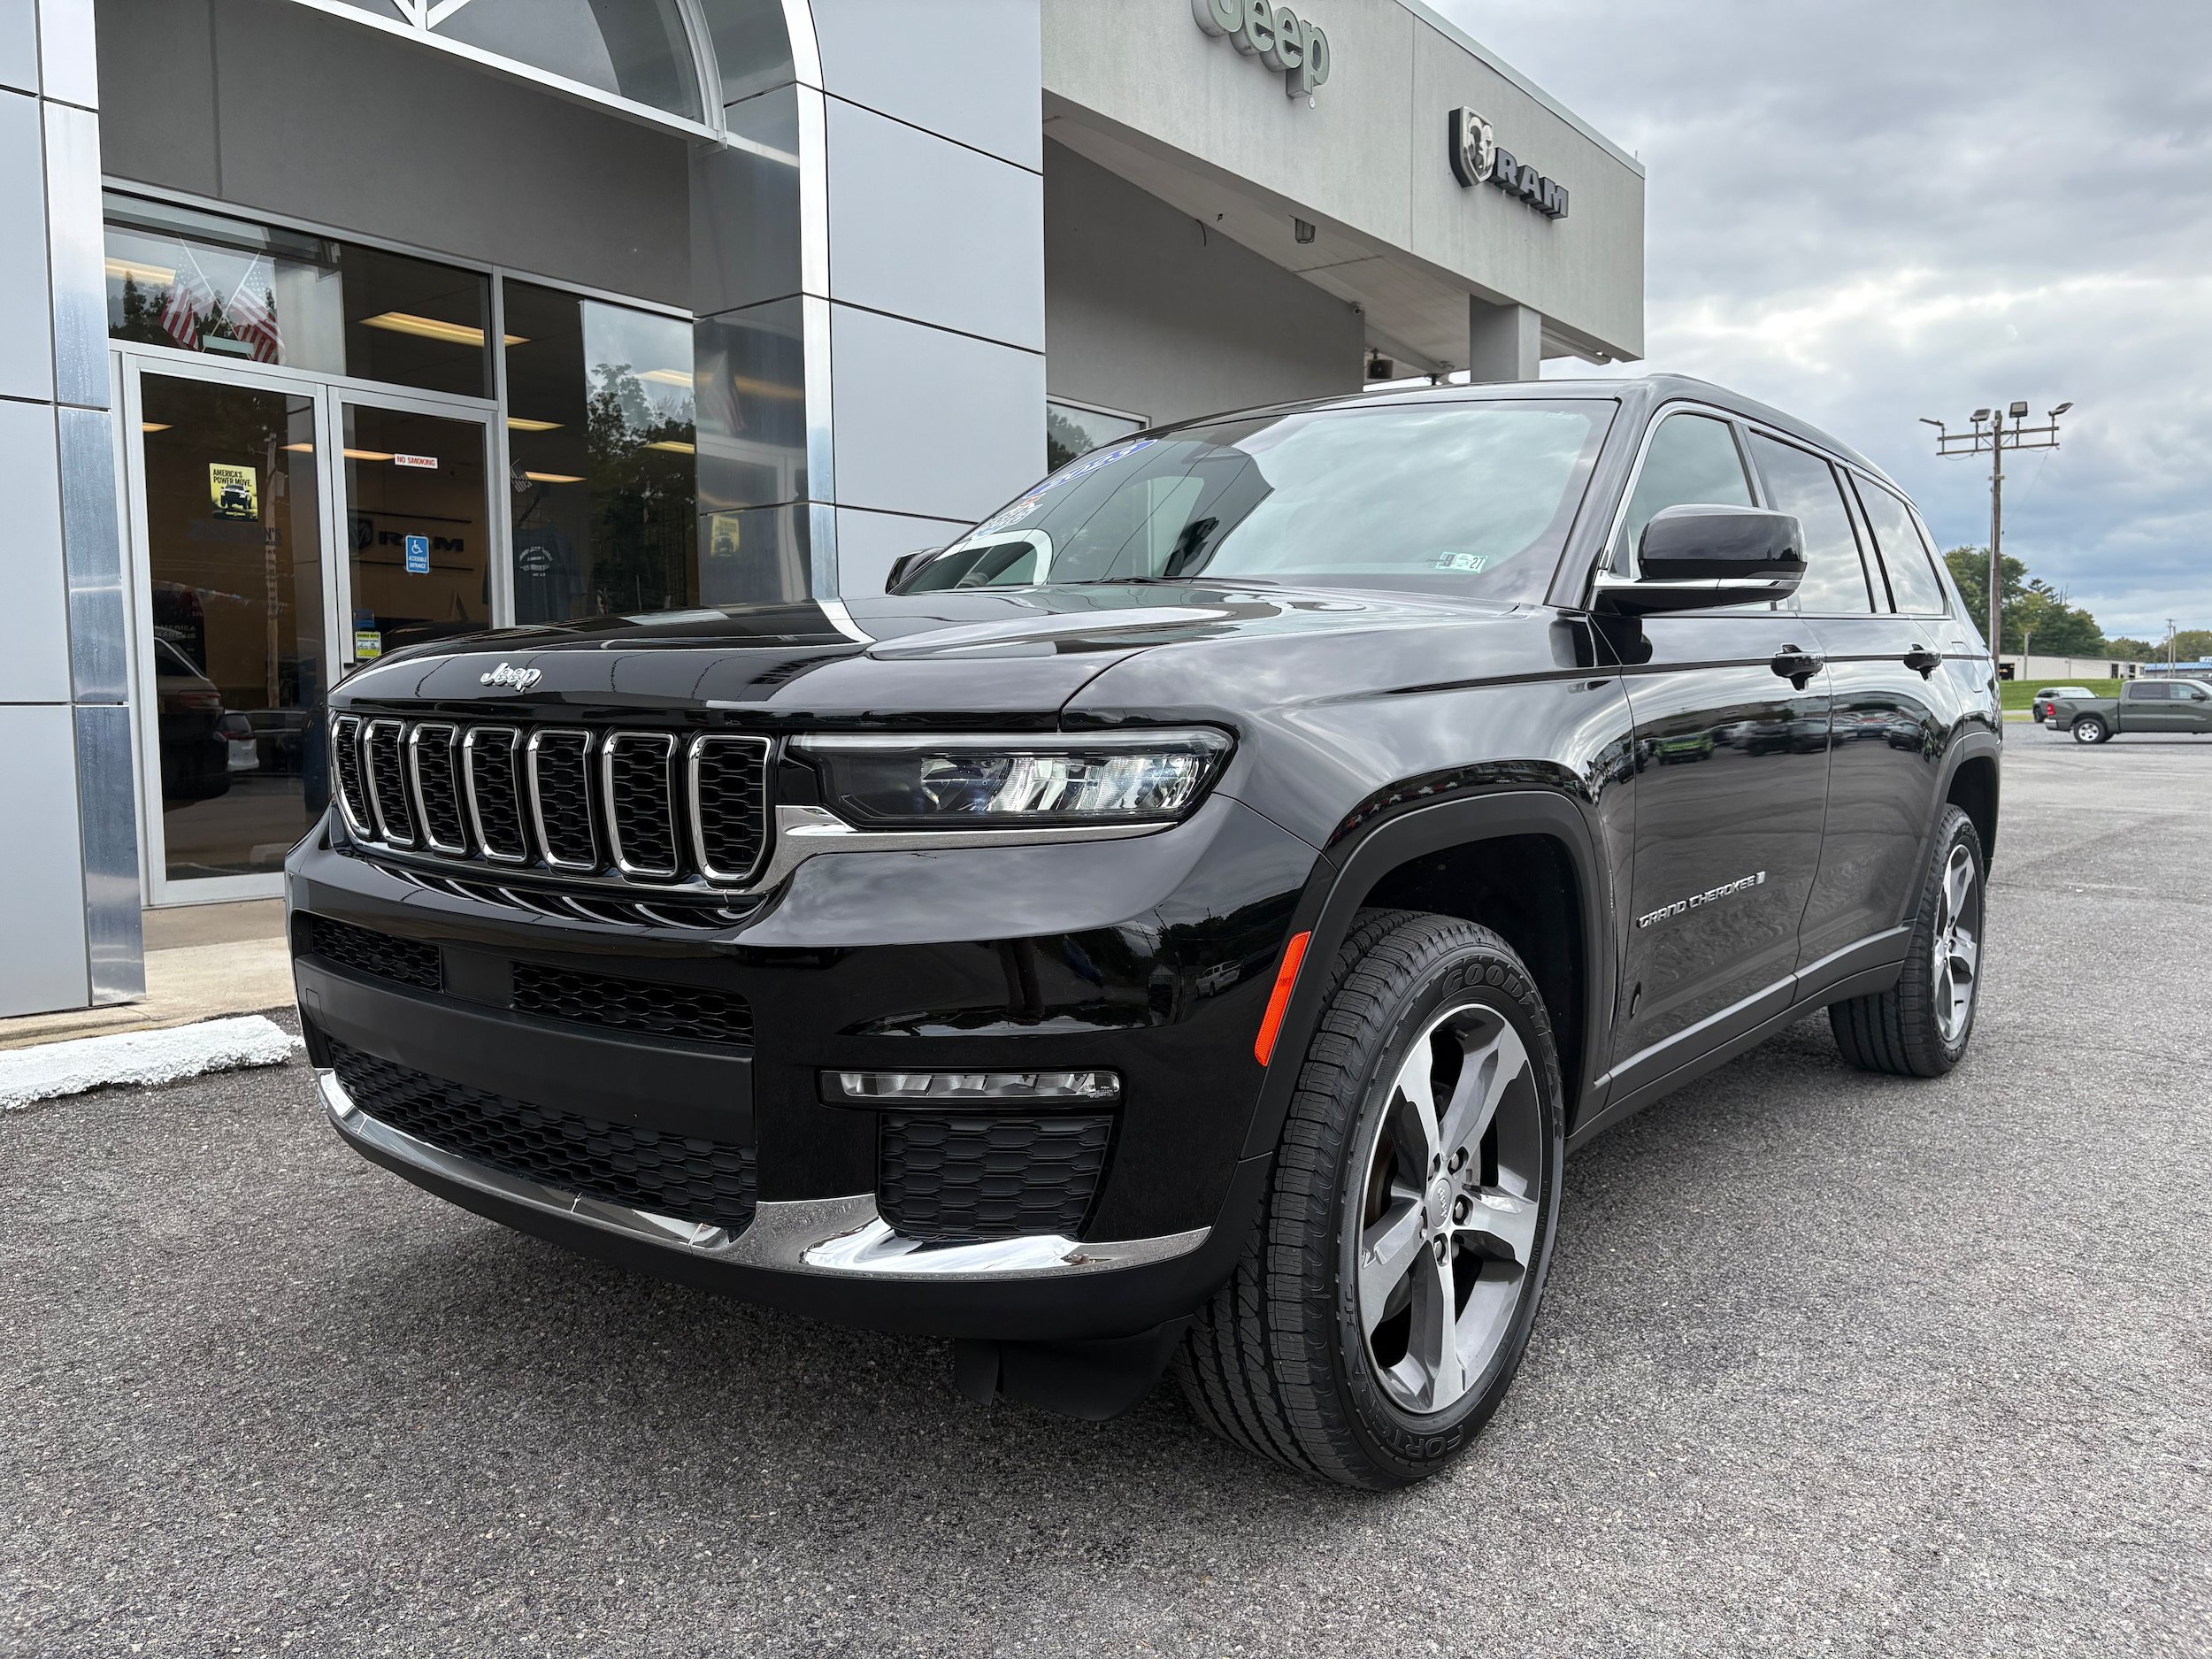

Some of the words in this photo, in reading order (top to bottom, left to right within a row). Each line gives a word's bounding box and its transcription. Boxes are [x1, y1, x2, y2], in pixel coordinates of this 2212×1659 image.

[1492, 147, 1569, 219] RAM
[407, 457, 436, 467] SMOKING
[212, 469, 243, 479] AMERICA'S
[213, 476, 234, 485] POWER
[379, 531, 465, 552] RM
[1470, 557, 1484, 570] 27
[480, 662, 542, 693] Jeep
[1638, 899, 1687, 929] GRAND
[1688, 874, 1756, 909] CHEROKEE
